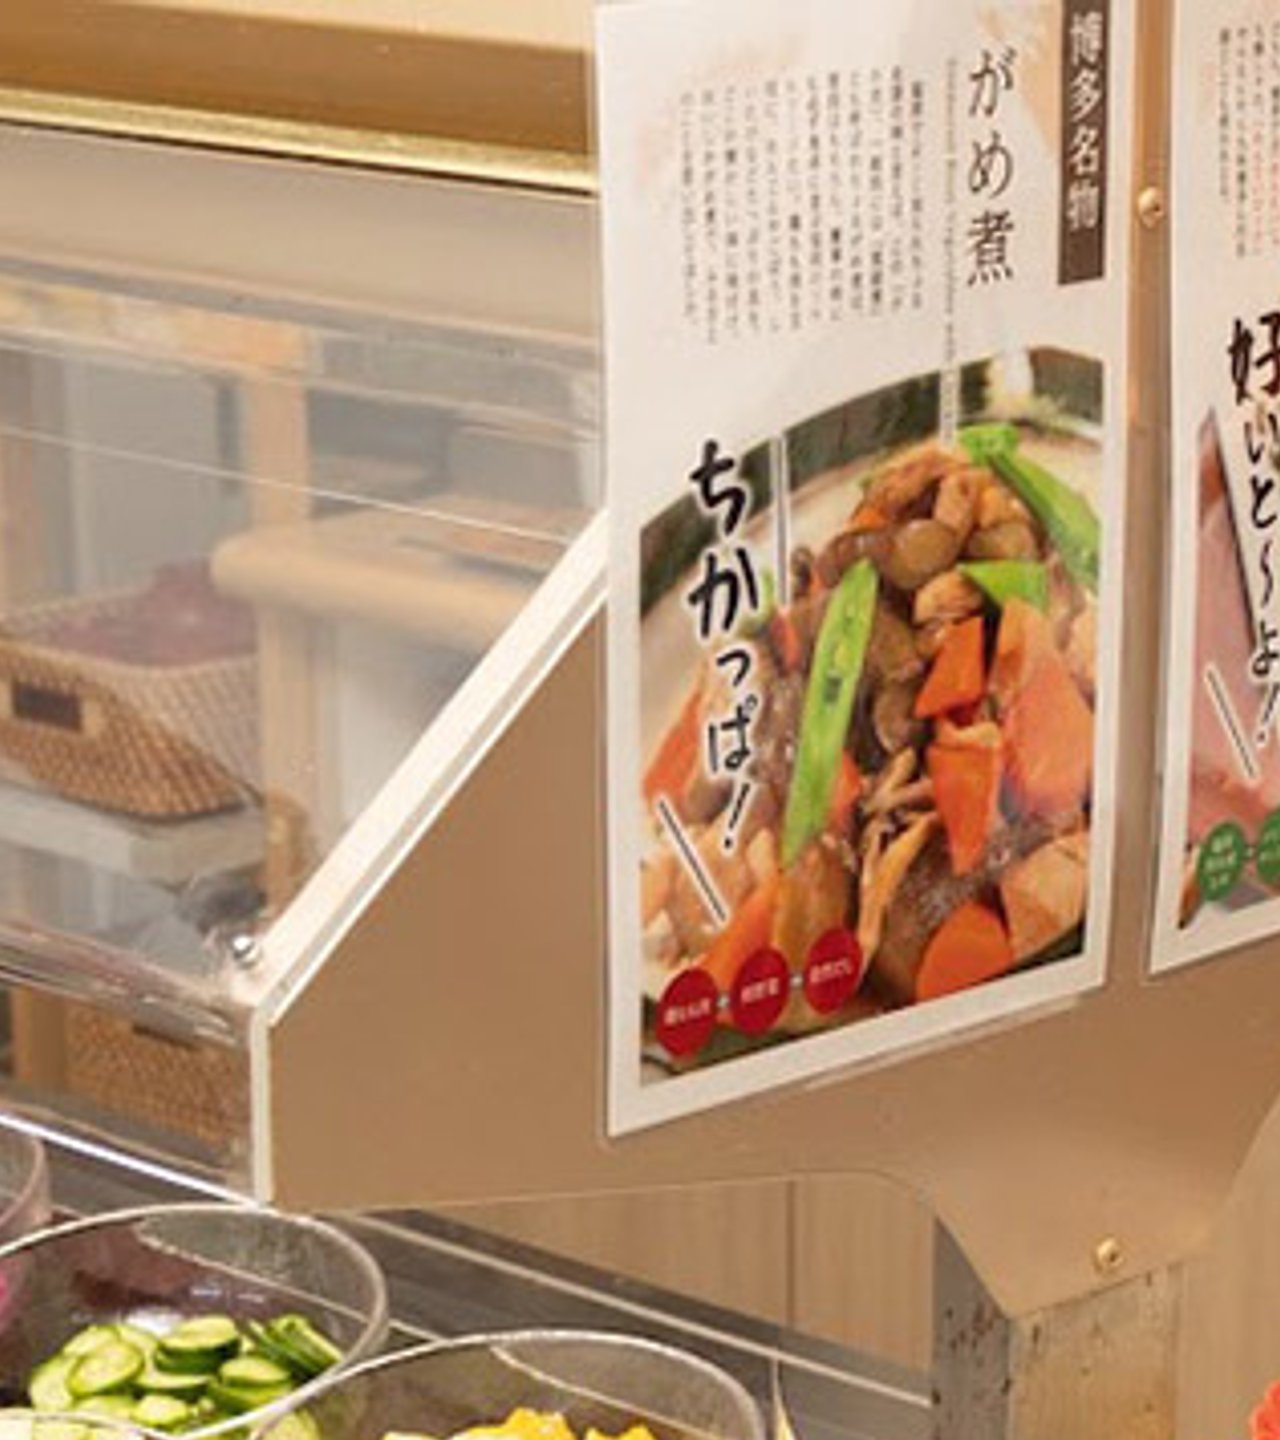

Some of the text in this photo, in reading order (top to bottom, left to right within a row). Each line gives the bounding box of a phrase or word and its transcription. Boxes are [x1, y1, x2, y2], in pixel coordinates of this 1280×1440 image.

[967, 47, 1018, 288] がめ煮
[1068, 10, 1104, 232] 博多名物
